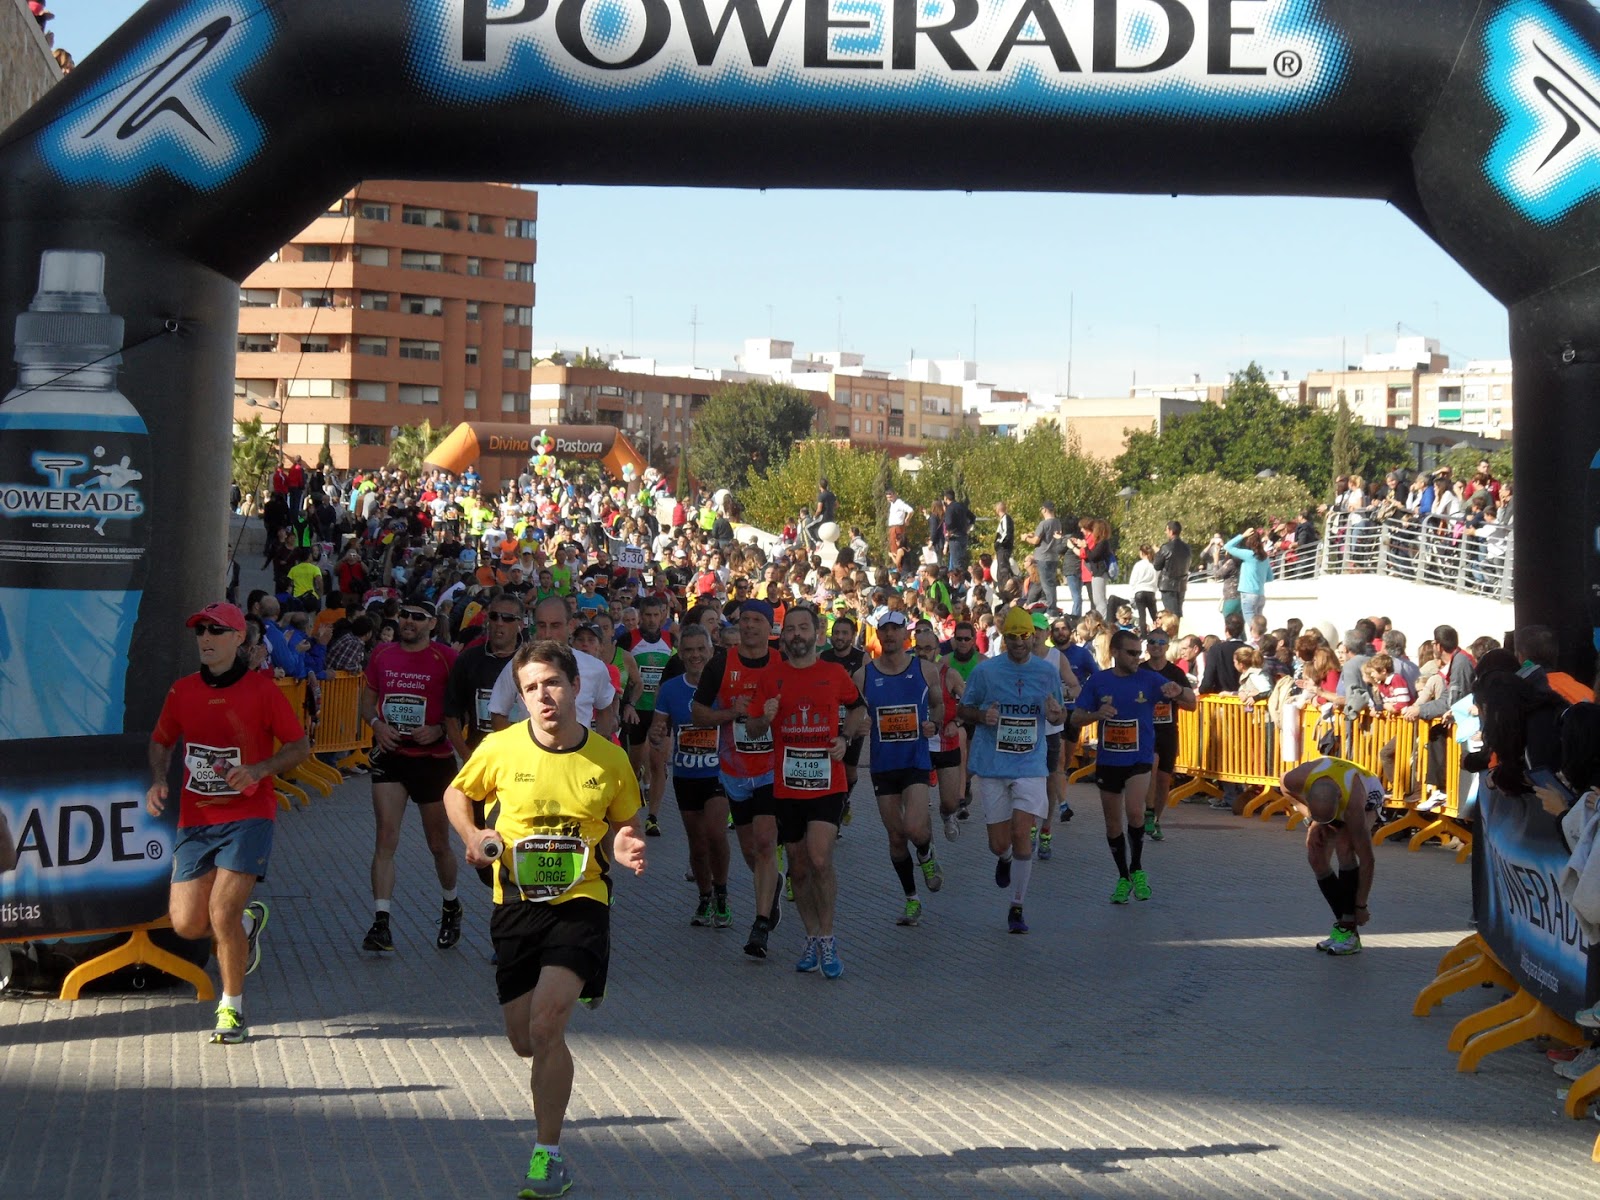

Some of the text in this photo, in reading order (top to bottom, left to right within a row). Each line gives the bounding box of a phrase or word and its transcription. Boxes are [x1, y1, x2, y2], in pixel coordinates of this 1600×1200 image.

[489, 435, 602, 453] Divina Pastora
[0, 489, 138, 512] OWERADE
[620, 552, 643, 564] 3:30
[385, 670, 431, 681] The runners
[386, 680, 425, 690] of Godella
[391, 705, 414, 713] 3.995
[795, 761, 819, 769] 4.149
[196, 771, 222, 780] OSCA
[789, 769, 824, 778] JOSE LUIS
[524, 842, 577, 850] Divina Pastora
[537, 857, 562, 868] 304
[533, 870, 566, 882] JORGE
[1, 903, 41, 922] tistas
